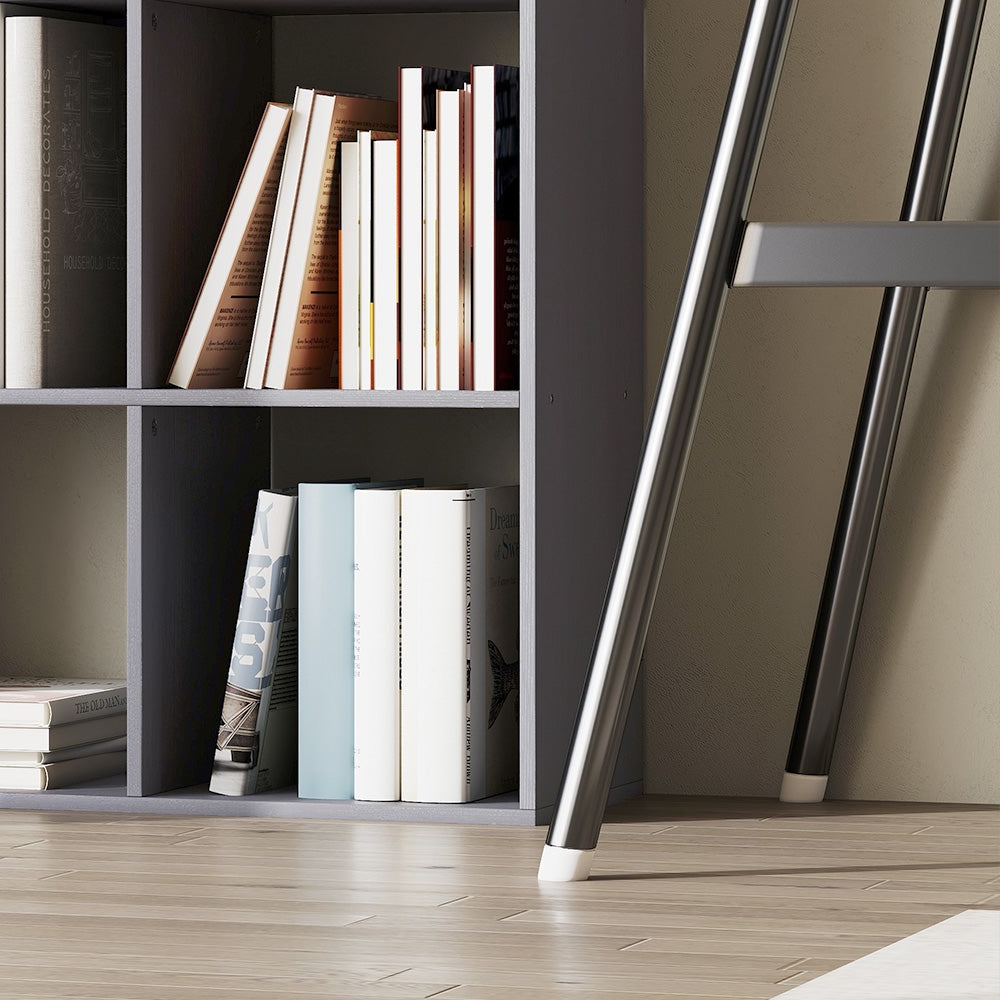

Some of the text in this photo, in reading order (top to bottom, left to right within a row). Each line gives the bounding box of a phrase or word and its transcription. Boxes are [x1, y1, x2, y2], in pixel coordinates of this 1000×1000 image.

[42, 68, 51, 333] HOUSEHOLD DECORATES
[75, 701, 89, 714] THE
[90, 698, 104, 711] OLD
